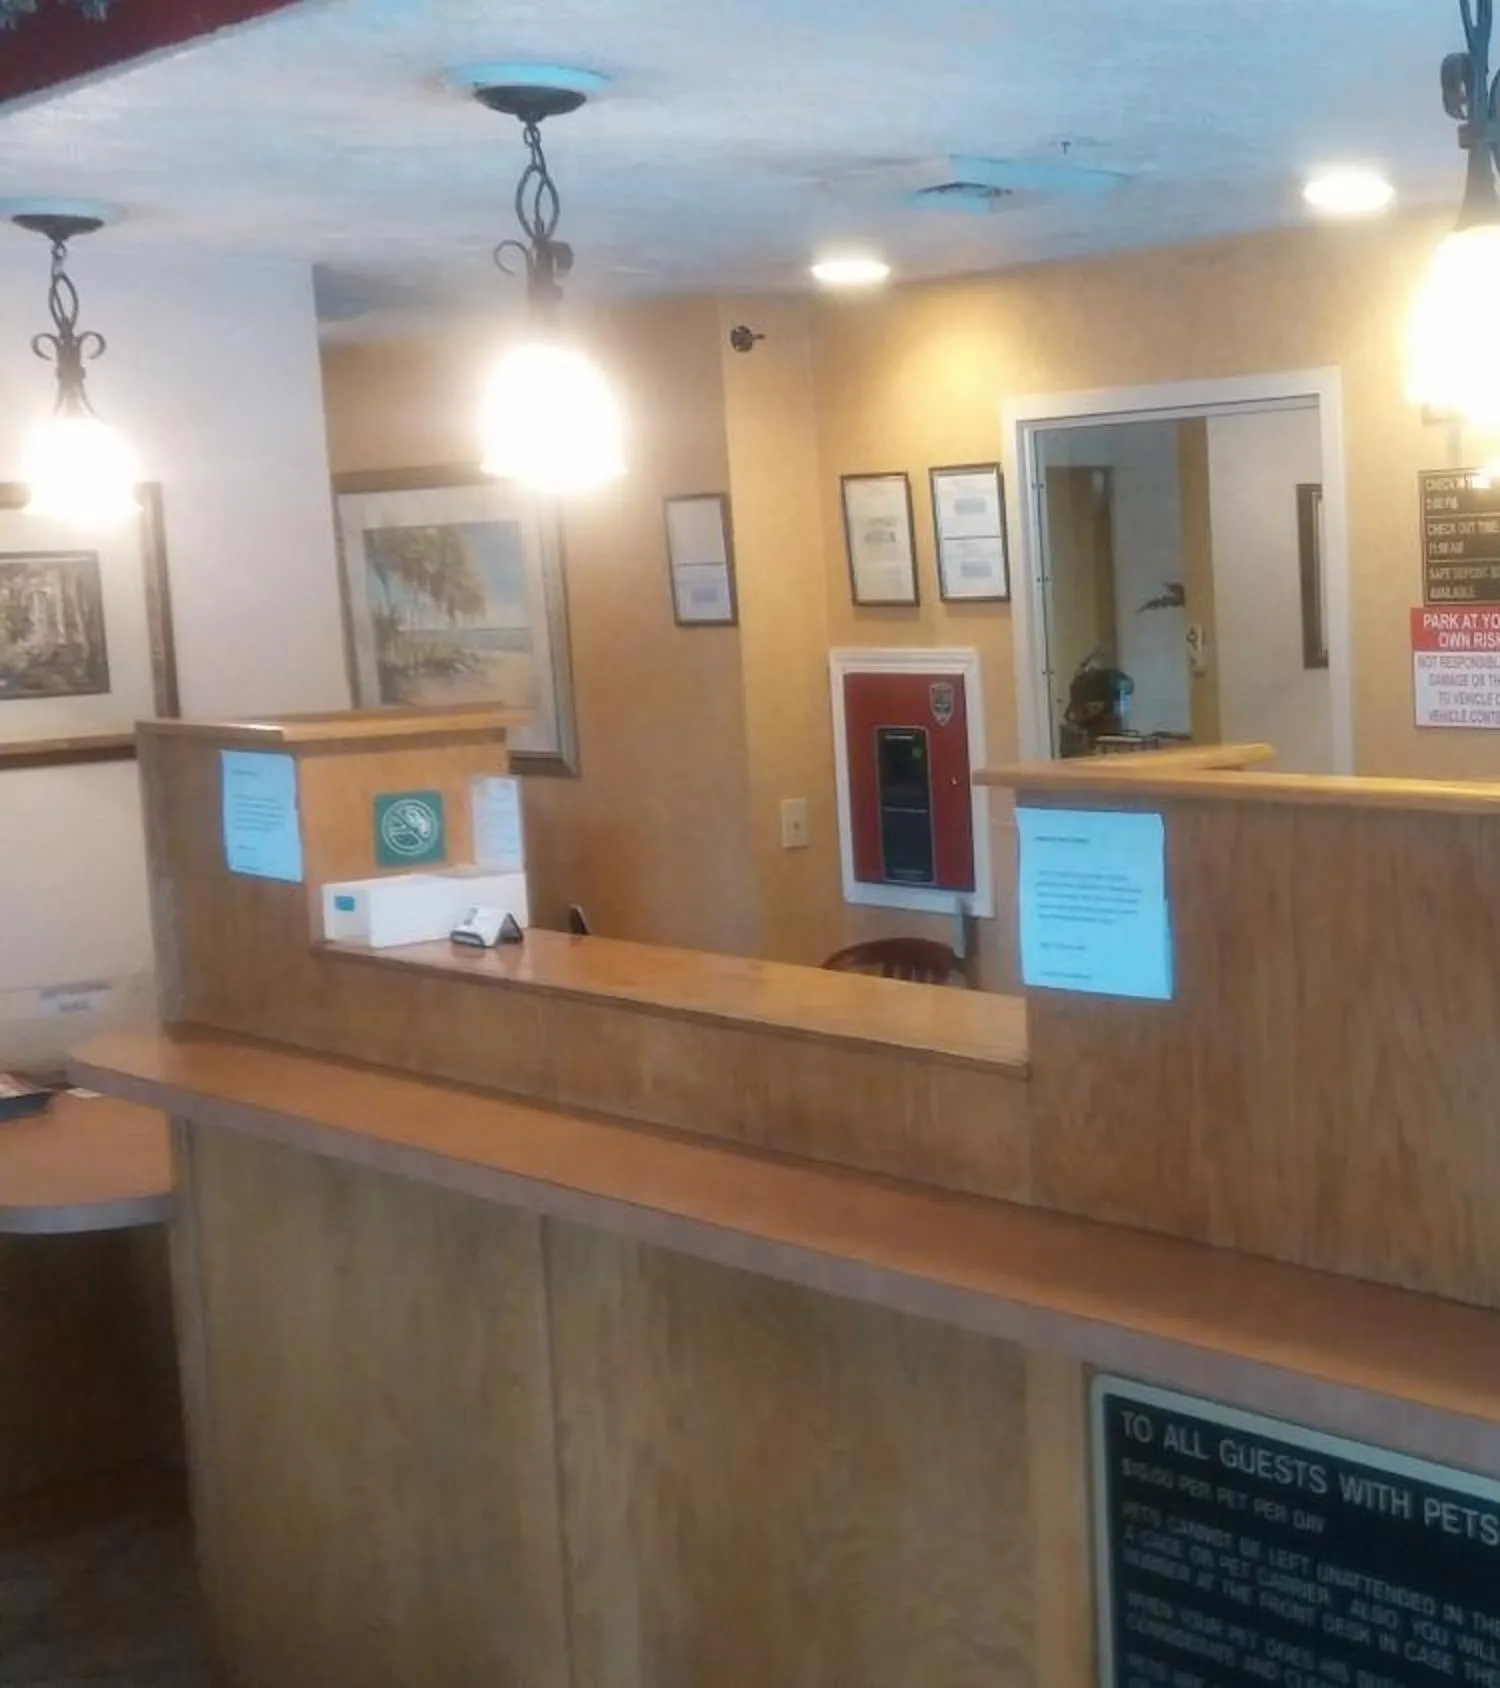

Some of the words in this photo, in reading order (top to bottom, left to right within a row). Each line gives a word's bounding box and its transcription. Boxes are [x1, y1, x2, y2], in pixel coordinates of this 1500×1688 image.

[1427, 523, 1456, 535] CHECK
[1457, 521, 1476, 534] OUT
[1423, 613, 1459, 629] PARK
[1461, 612, 1479, 629] AT
[1439, 632, 1470, 648] OWN
[1419, 656, 1438, 669] NOT
[1471, 674, 1486, 687] OR
[1439, 692, 1451, 705] TO
[1453, 692, 1494, 705] VEHICLE
[1429, 709, 1467, 724] VEHICLE
[1121, 1411, 1152, 1443] TO
[1163, 1423, 1209, 1460] ALL
[1218, 1438, 1328, 1495] GUESTS
[1339, 1472, 1412, 1521] WITH
[1423, 1497, 1500, 1547] PETS
[1178, 1475, 1212, 1499] PER
[1215, 1486, 1249, 1510] PET
[1253, 1497, 1288, 1524] PER
[1292, 1509, 1327, 1535] DAY
[1166, 1515, 1233, 1550] CANNOT
[1268, 1547, 1311, 1577] LEFT
[1316, 1561, 1437, 1618] UNATTENDED
[1442, 1602, 1465, 1626] IN
[1218, 1554, 1253, 1579] PET
[1412, 1617, 1449, 1647] YOU
[1455, 1632, 1500, 1665] WILL
[1259, 1591, 1317, 1627] FRONT
[1322, 1612, 1371, 1645] DESK
[1379, 1631, 1399, 1655] IN
[1404, 1640, 1455, 1676] CASE
